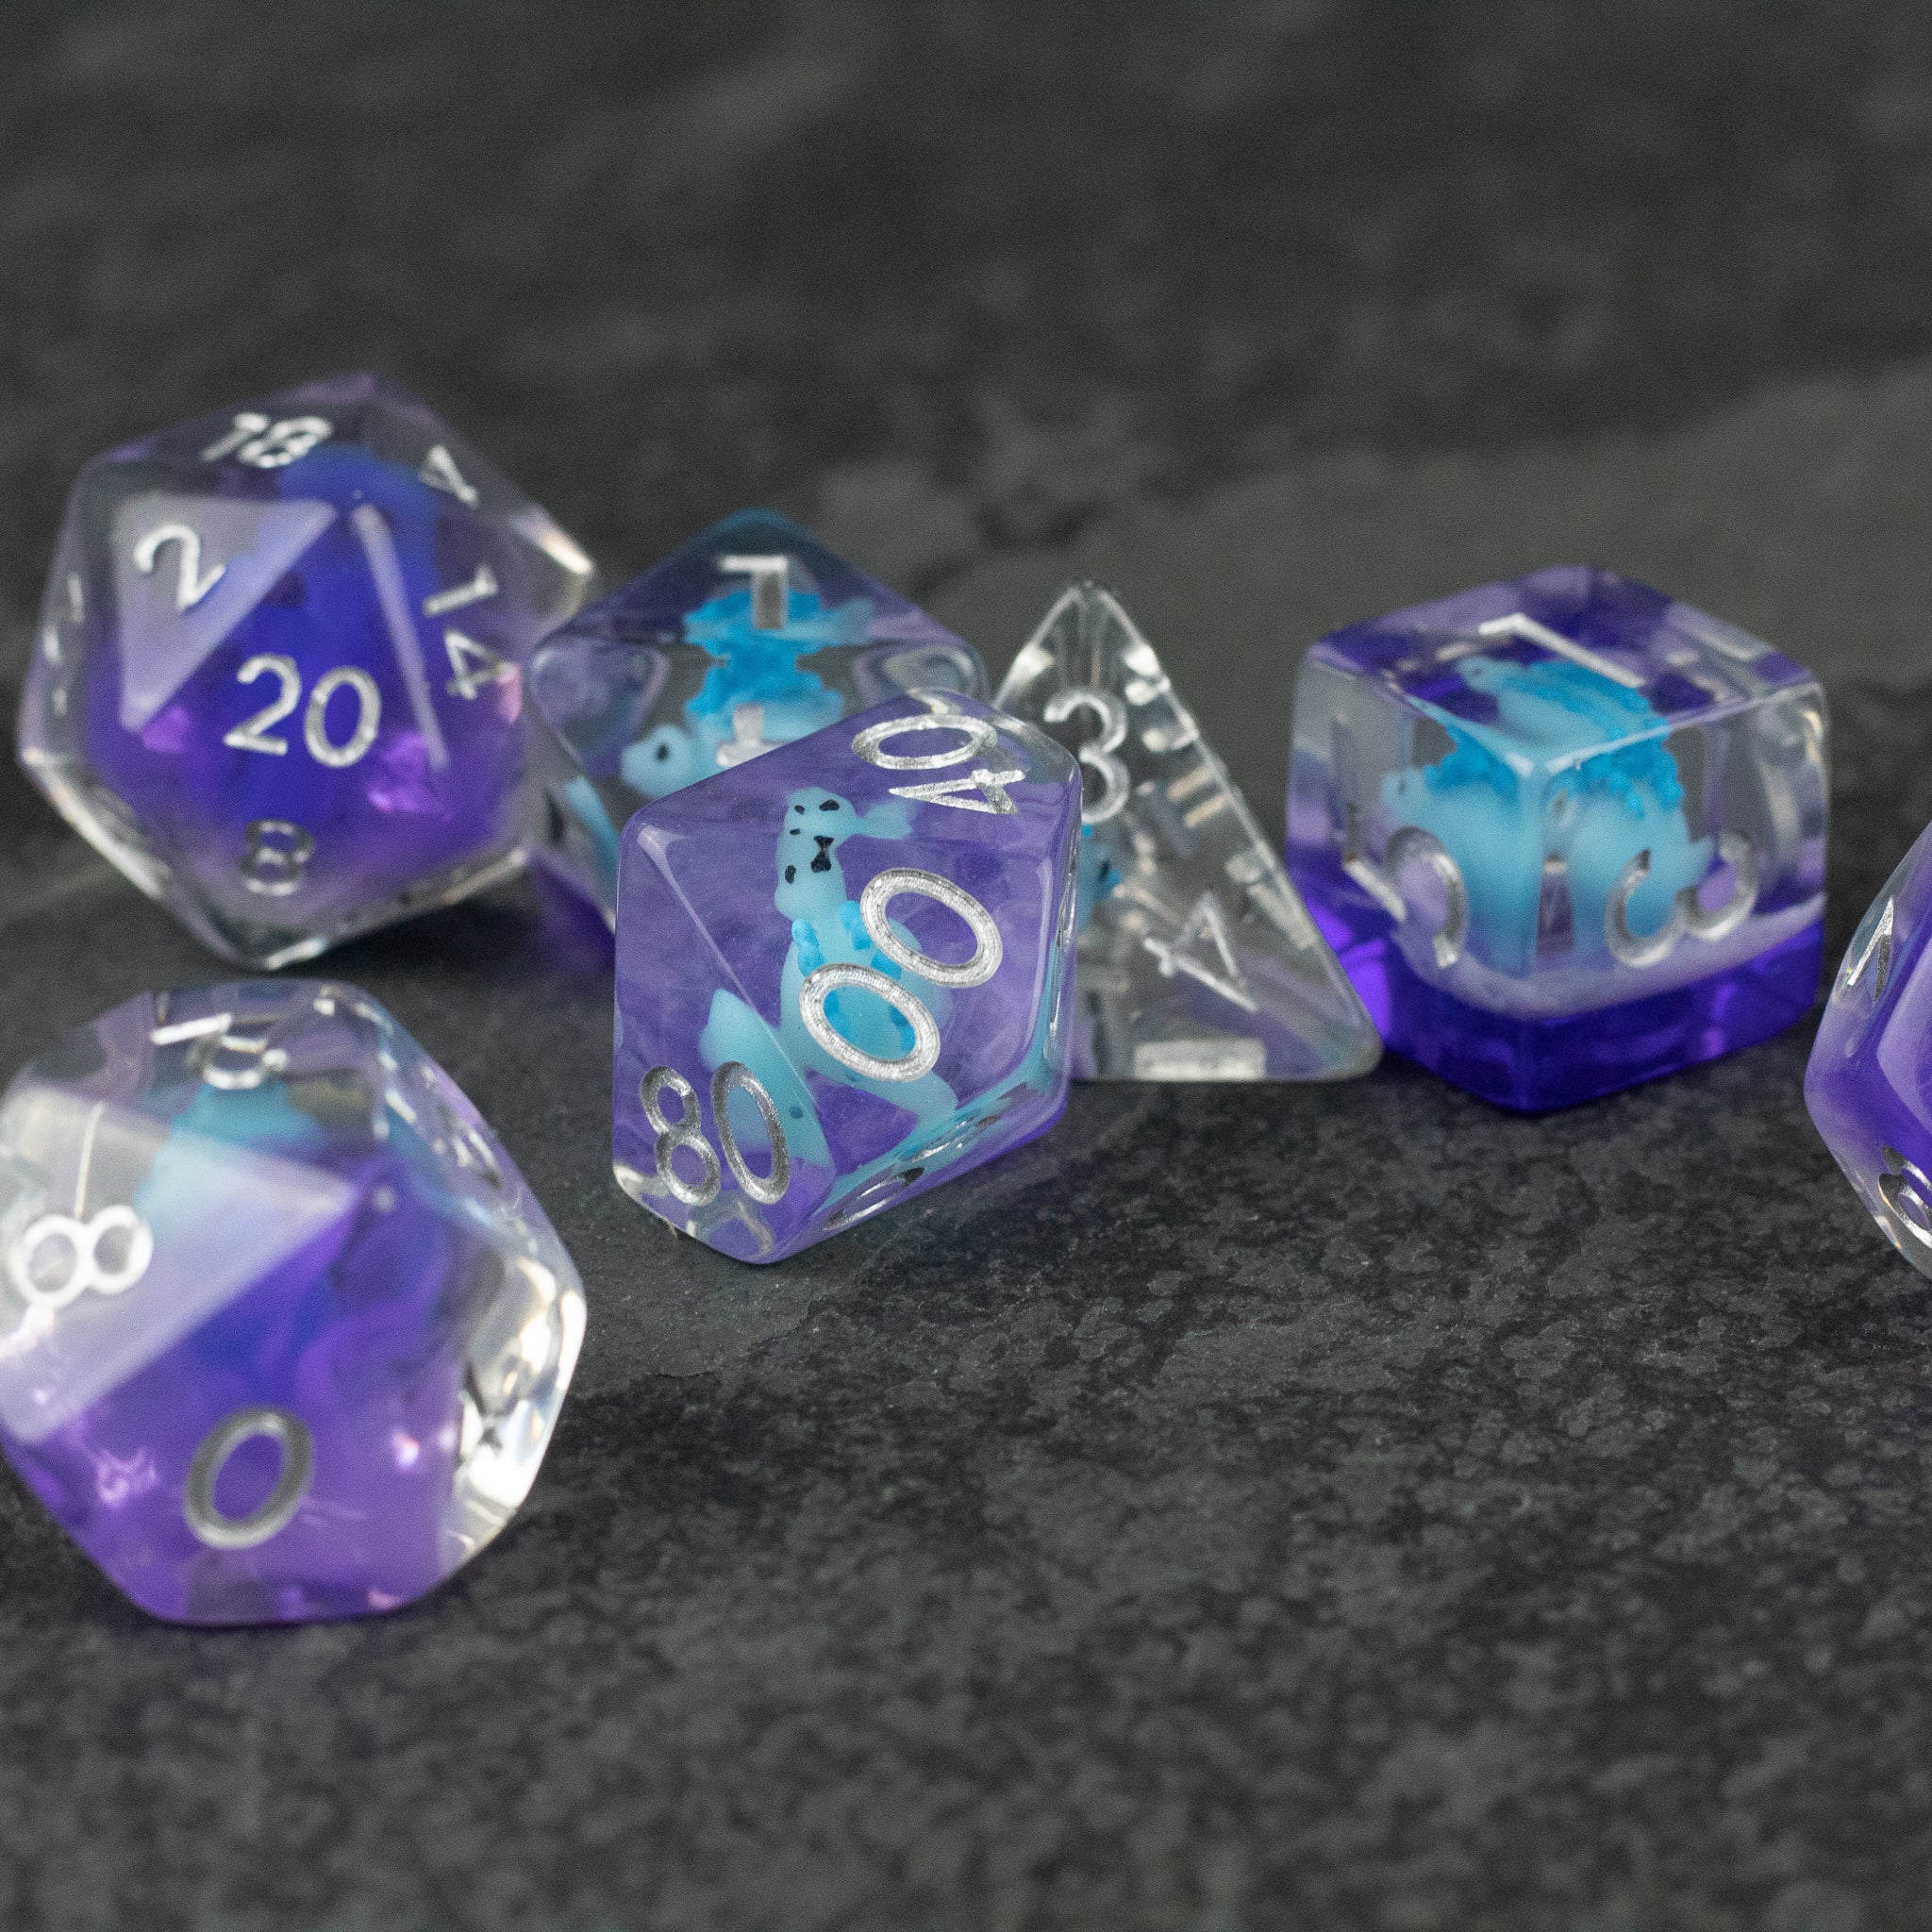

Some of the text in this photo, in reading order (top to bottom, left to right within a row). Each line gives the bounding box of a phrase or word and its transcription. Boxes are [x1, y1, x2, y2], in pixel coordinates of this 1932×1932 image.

[133, 525, 225, 613] 2
[224, 654, 380, 768] 20
[852, 714, 1026, 815] 40
[1043, 688, 1130, 824] 3
[240, 819, 314, 897] 8
[798, 866, 1004, 1084] 00
[639, 1060, 791, 1207] 80
[8, 1204, 155, 1311] 8
[184, 1407, 315, 1551] 0
